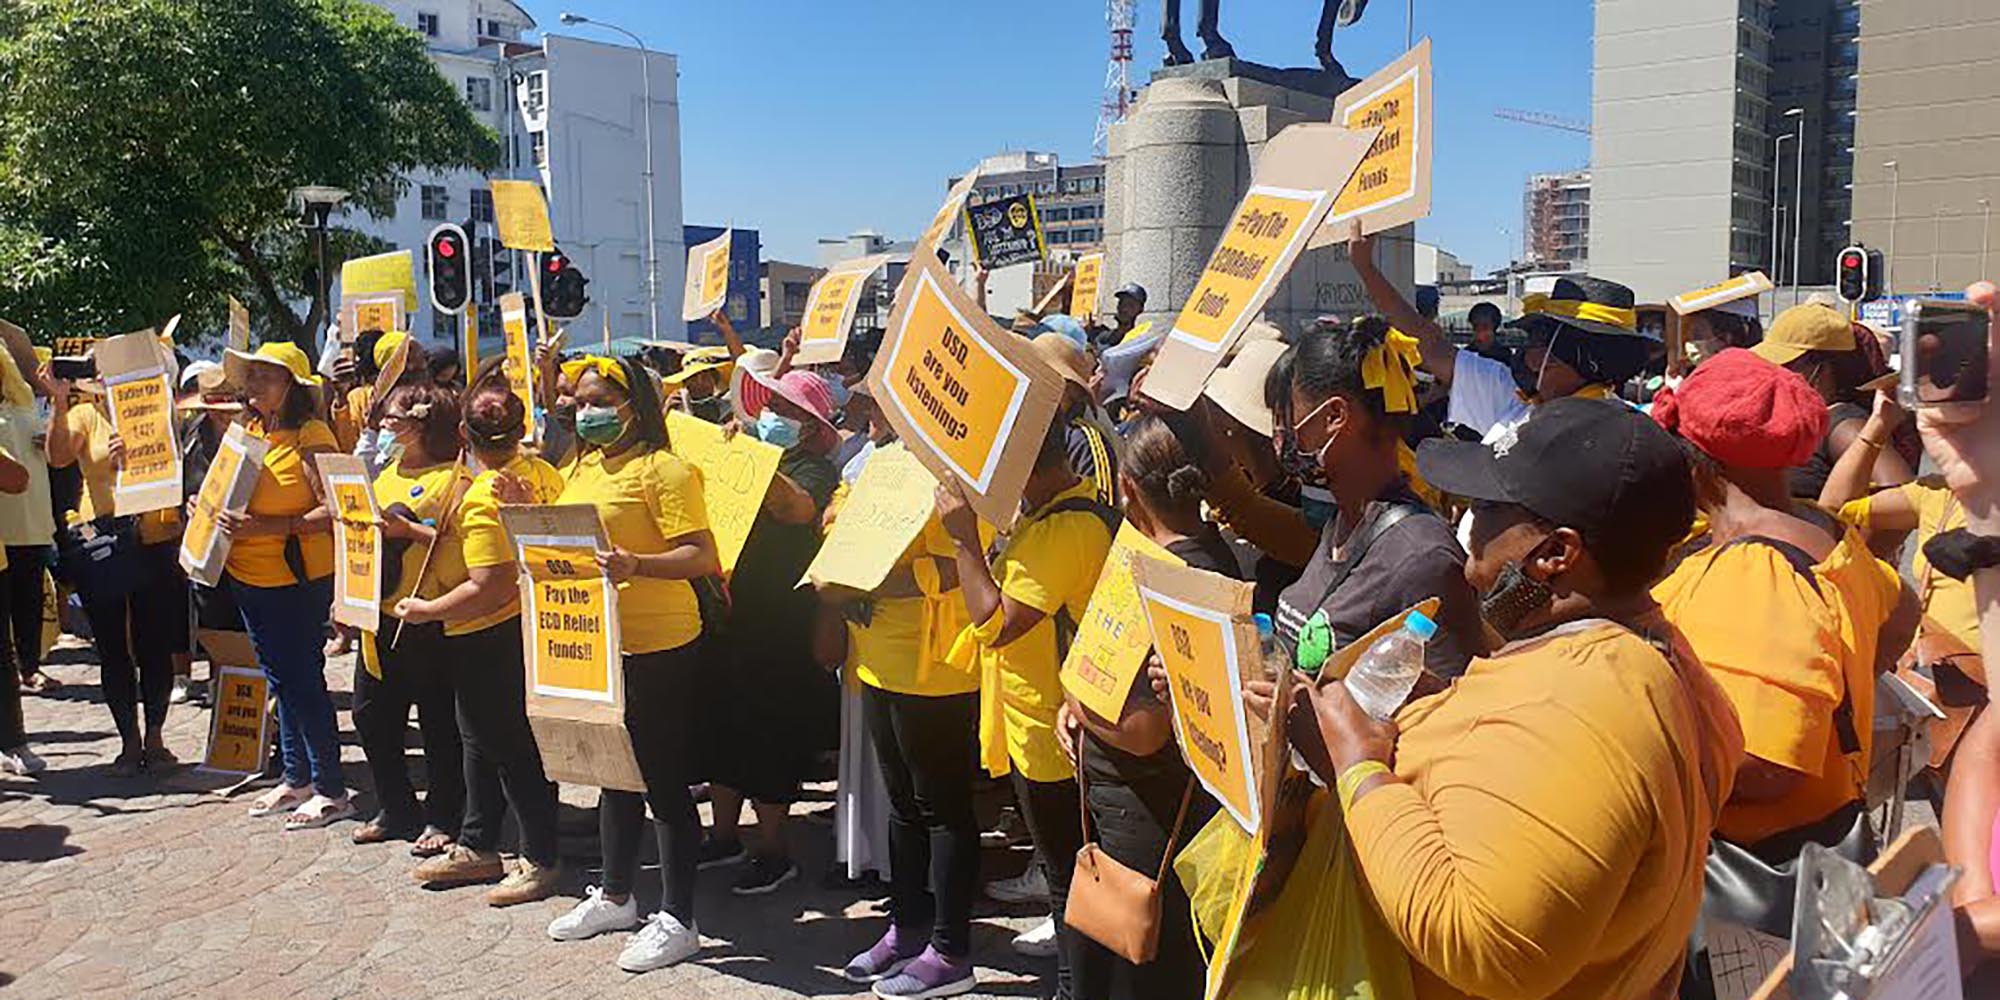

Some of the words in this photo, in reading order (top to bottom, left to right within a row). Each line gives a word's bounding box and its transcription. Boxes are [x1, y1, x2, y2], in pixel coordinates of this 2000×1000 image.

[1357, 166, 1388, 193] Funds
[1237, 208, 1288, 239] #PayThe
[1193, 287, 1229, 319] Funds
[941, 326, 969, 370] DSD,
[923, 349, 945, 381] are
[942, 372, 970, 407] you
[905, 365, 968, 440] listening?
[544, 585, 566, 605] Pay
[569, 586, 590, 603] the
[539, 611, 561, 630] ECD
[563, 613, 600, 633] Relief
[548, 640, 592, 661] Funds!!
